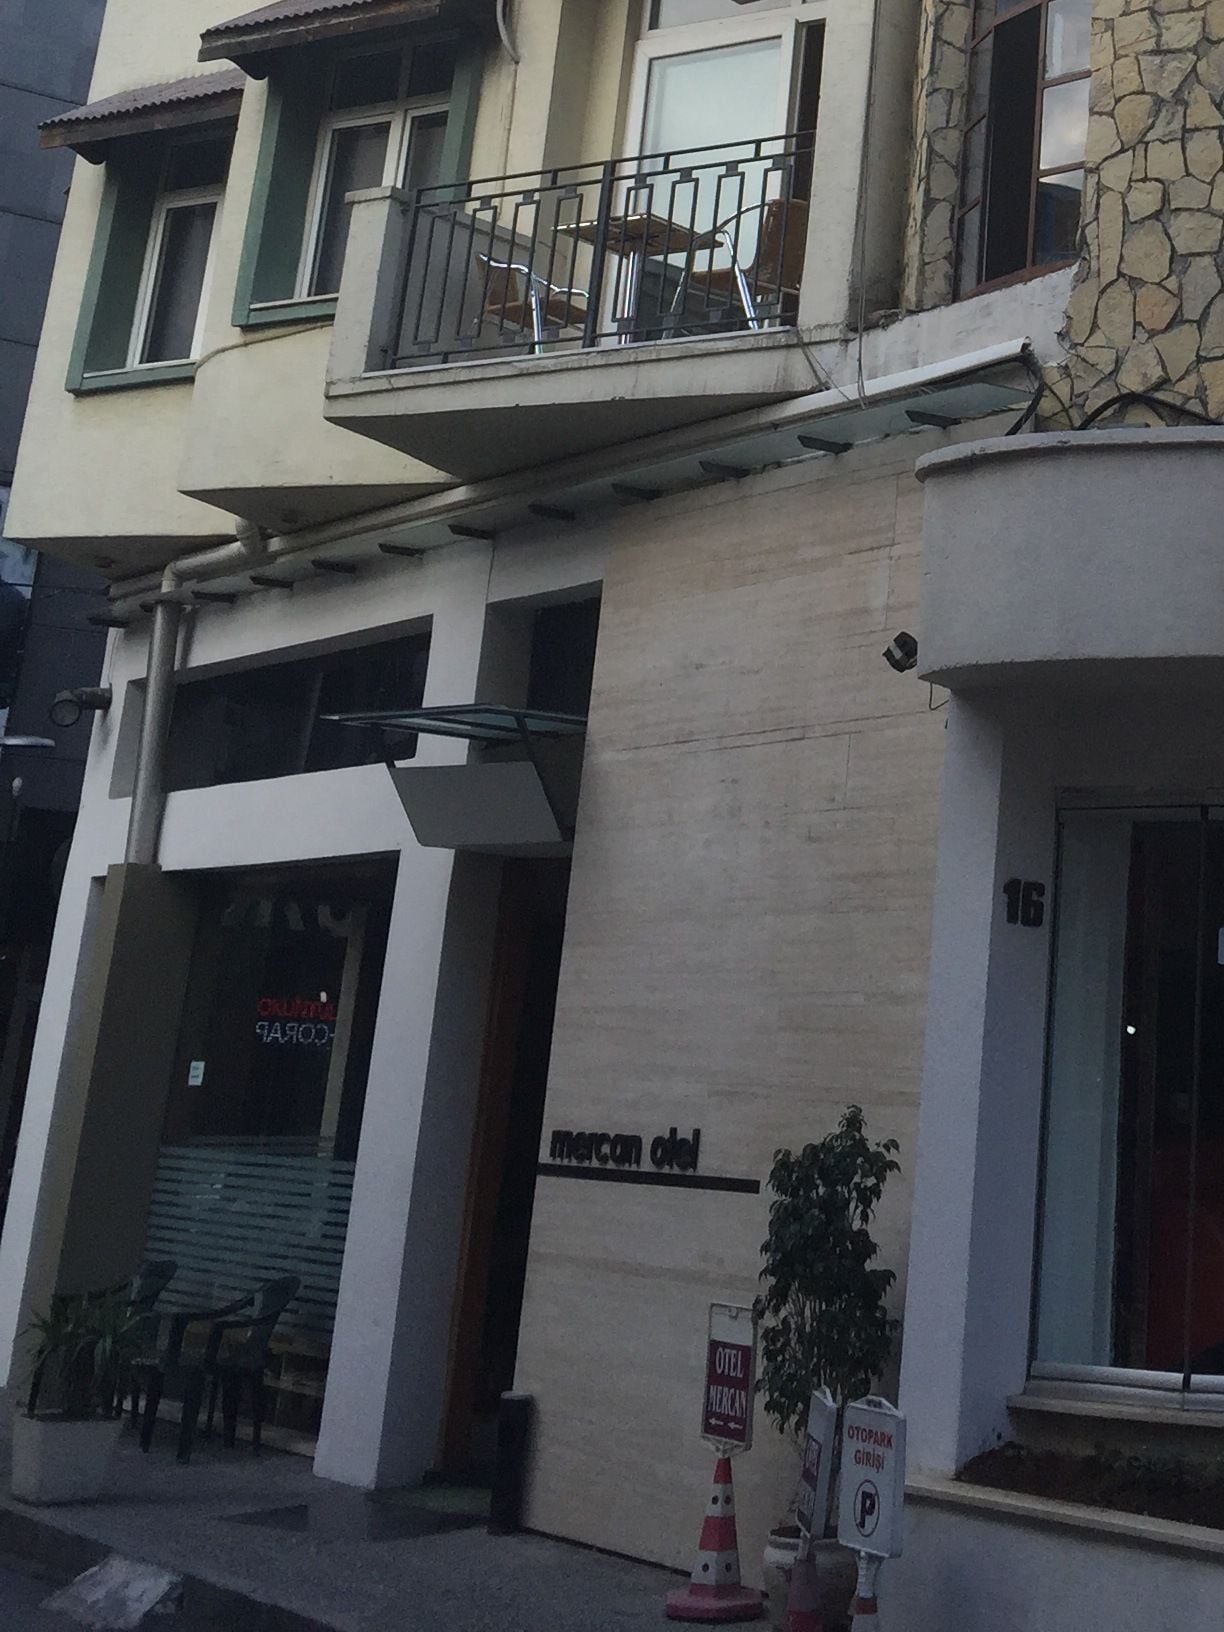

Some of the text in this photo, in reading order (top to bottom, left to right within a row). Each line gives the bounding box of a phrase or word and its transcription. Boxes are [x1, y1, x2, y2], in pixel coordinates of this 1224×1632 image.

[1003, 878, 1045, 927] 16
[550, 1129, 643, 1168] mercan
[715, 1347, 744, 1379] OTEL
[708, 1384, 747, 1419] MERCAN
[847, 1424, 894, 1451] OTOPARK
[854, 1448, 886, 1473] GİRİŞİ
